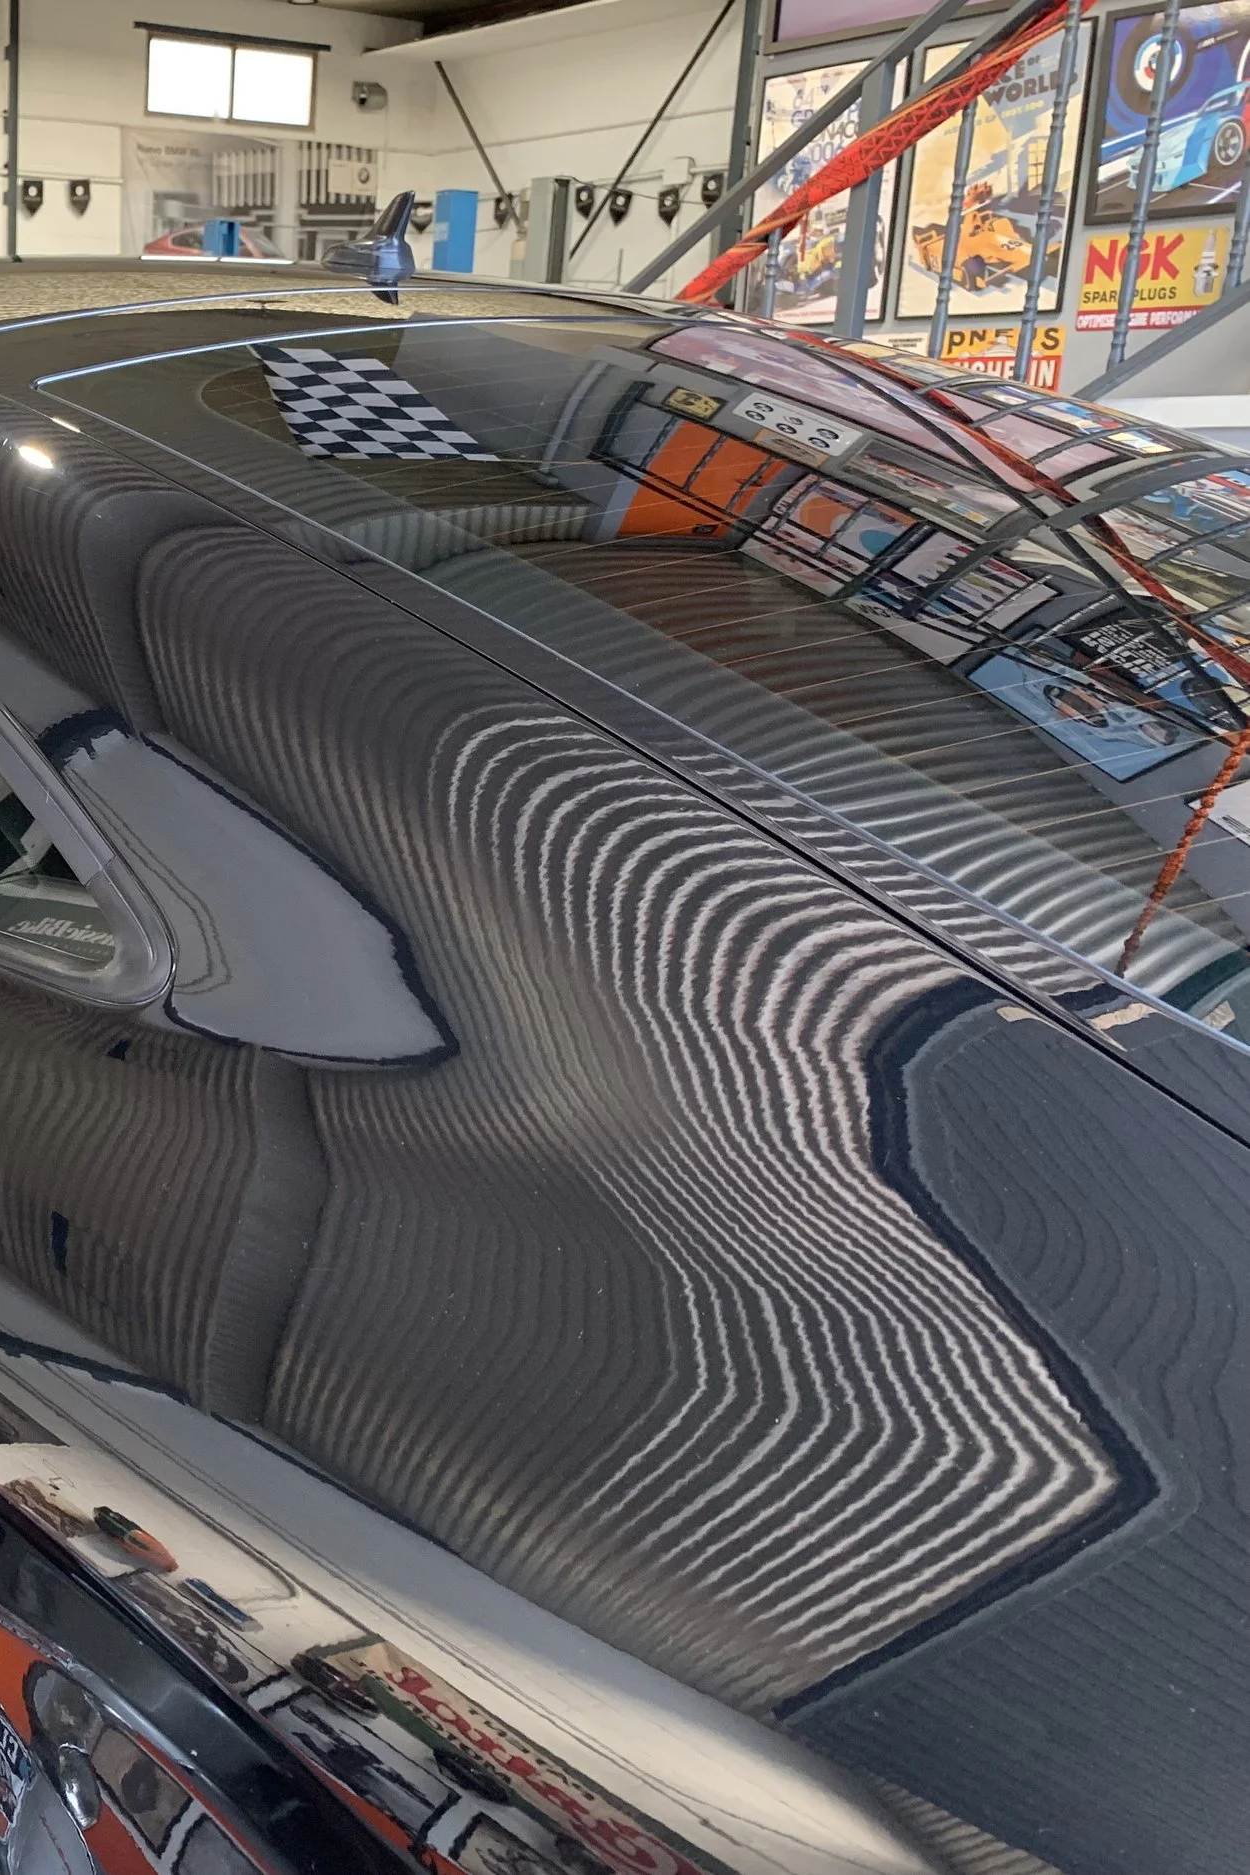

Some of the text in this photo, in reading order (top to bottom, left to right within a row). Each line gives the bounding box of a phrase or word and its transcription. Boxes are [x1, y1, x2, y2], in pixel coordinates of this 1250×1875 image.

[1084, 233, 1184, 284] NGK
[1083, 287, 1177, 304] SPAR PLUGS
[947, 327, 1060, 355] PNES
